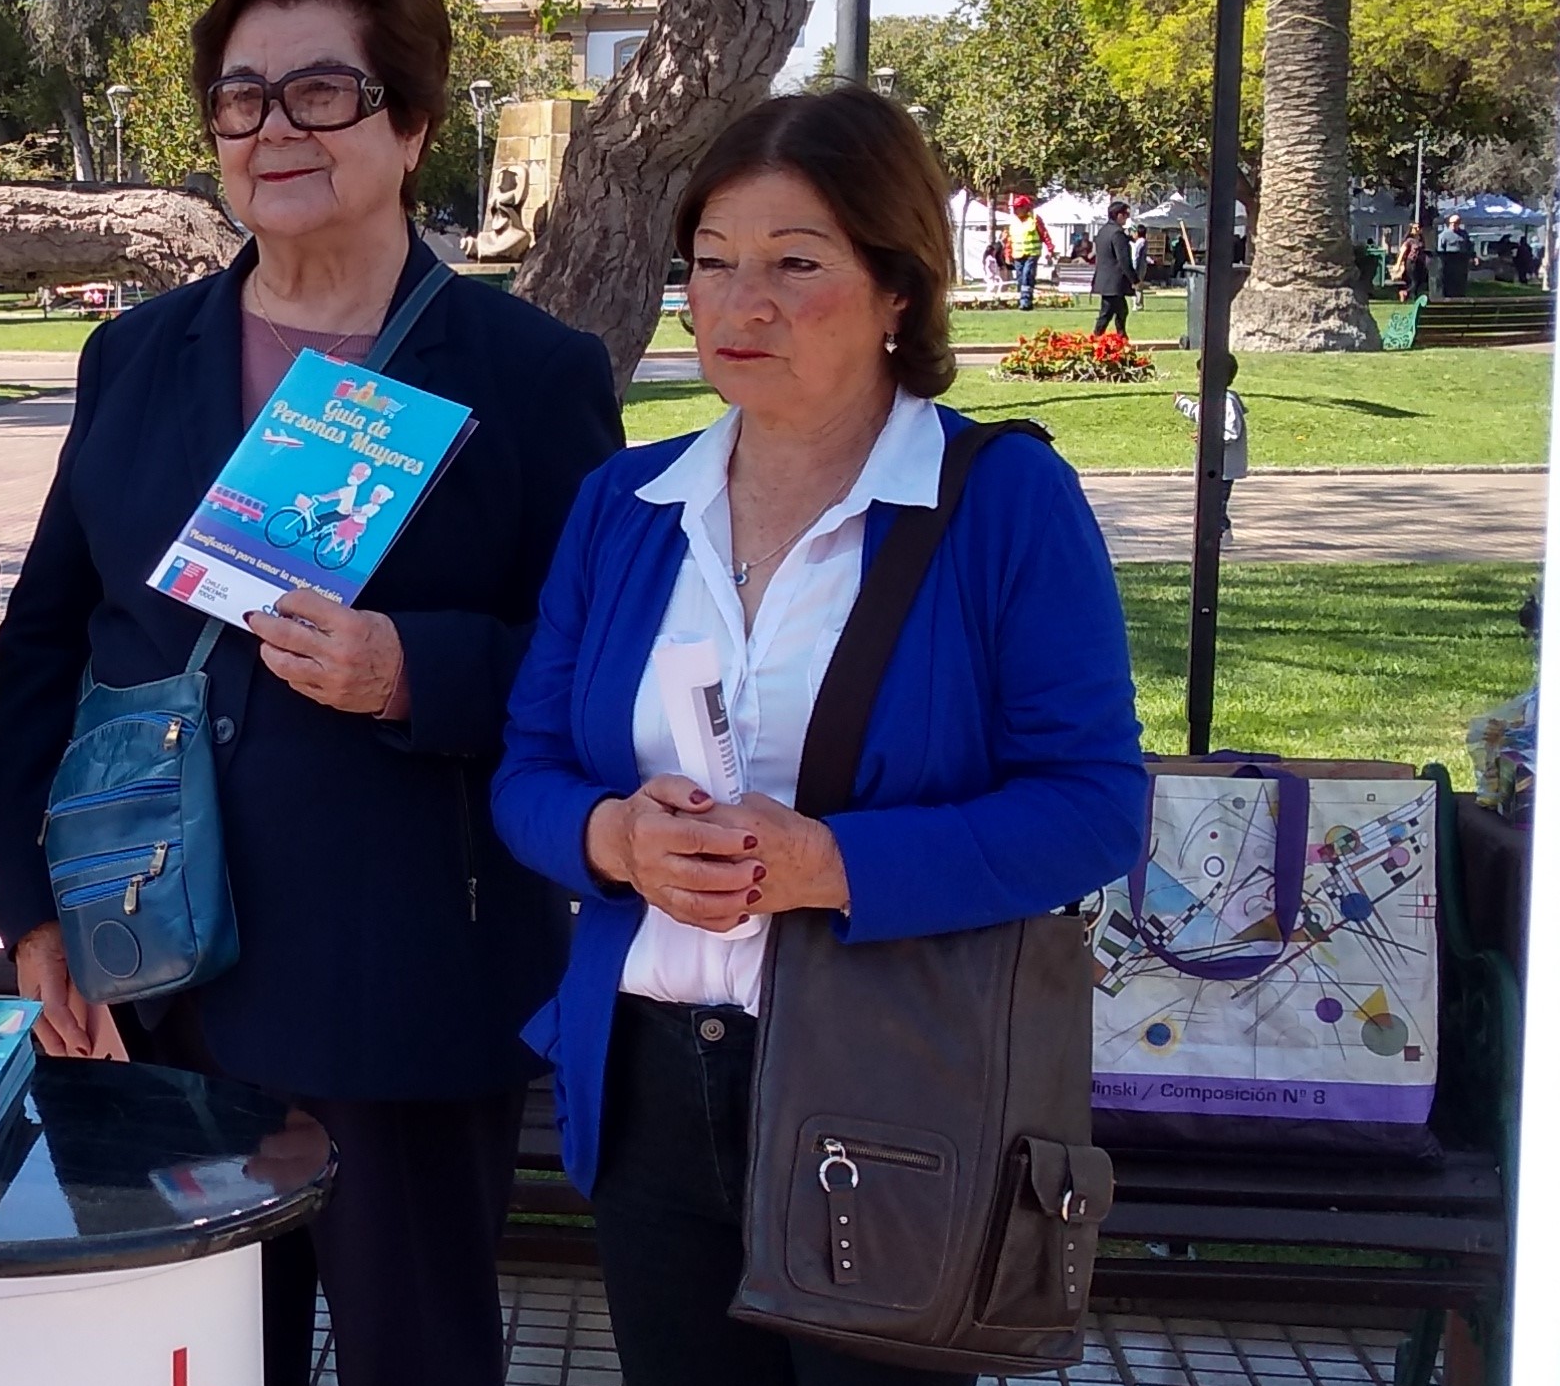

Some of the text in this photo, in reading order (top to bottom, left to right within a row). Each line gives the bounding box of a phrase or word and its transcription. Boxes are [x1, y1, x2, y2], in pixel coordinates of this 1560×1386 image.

[270, 400, 425, 476] Personas Mayores
[323, 399, 392, 440] Guía de
[190, 528, 237, 557] Planificación
[234, 550, 256, 564] para
[256, 559, 280, 575] tomar
[1160, 1082, 1277, 1102] Composición
[1313, 1088, 1327, 1105] 8
